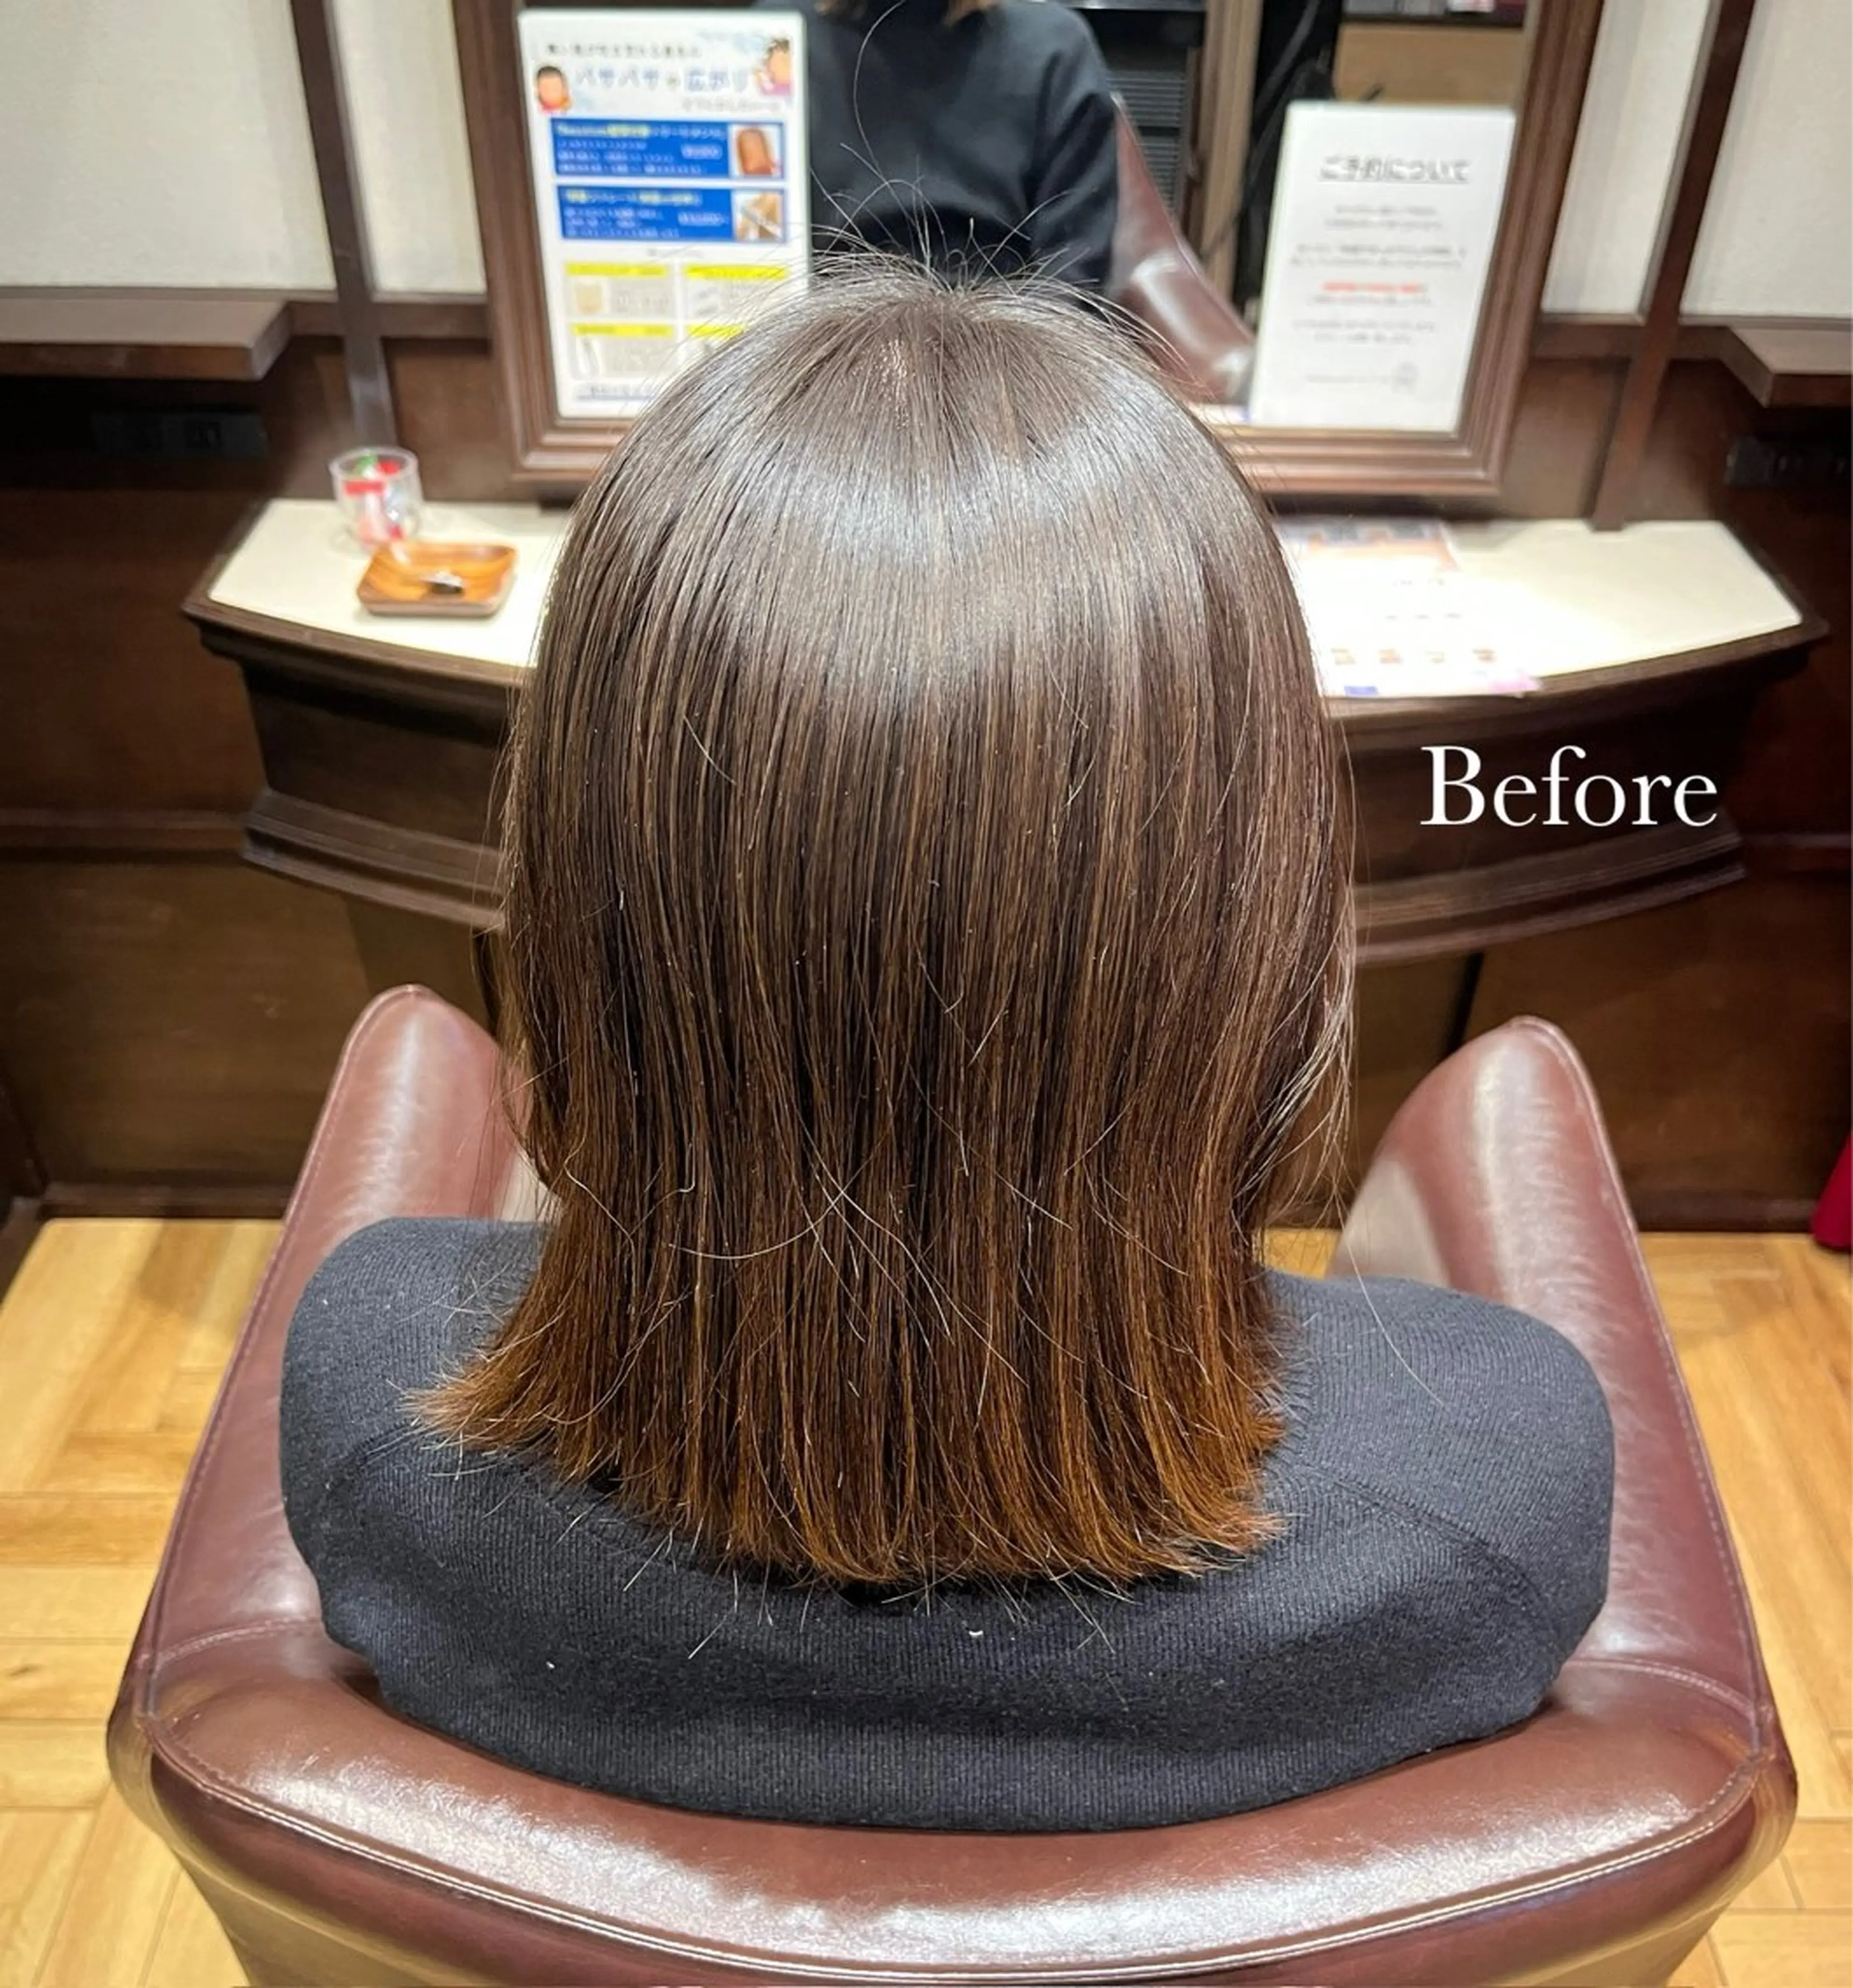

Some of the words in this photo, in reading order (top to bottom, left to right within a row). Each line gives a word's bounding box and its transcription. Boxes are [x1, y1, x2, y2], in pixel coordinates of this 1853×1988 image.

[1320, 155, 1471, 182] ご予約について
